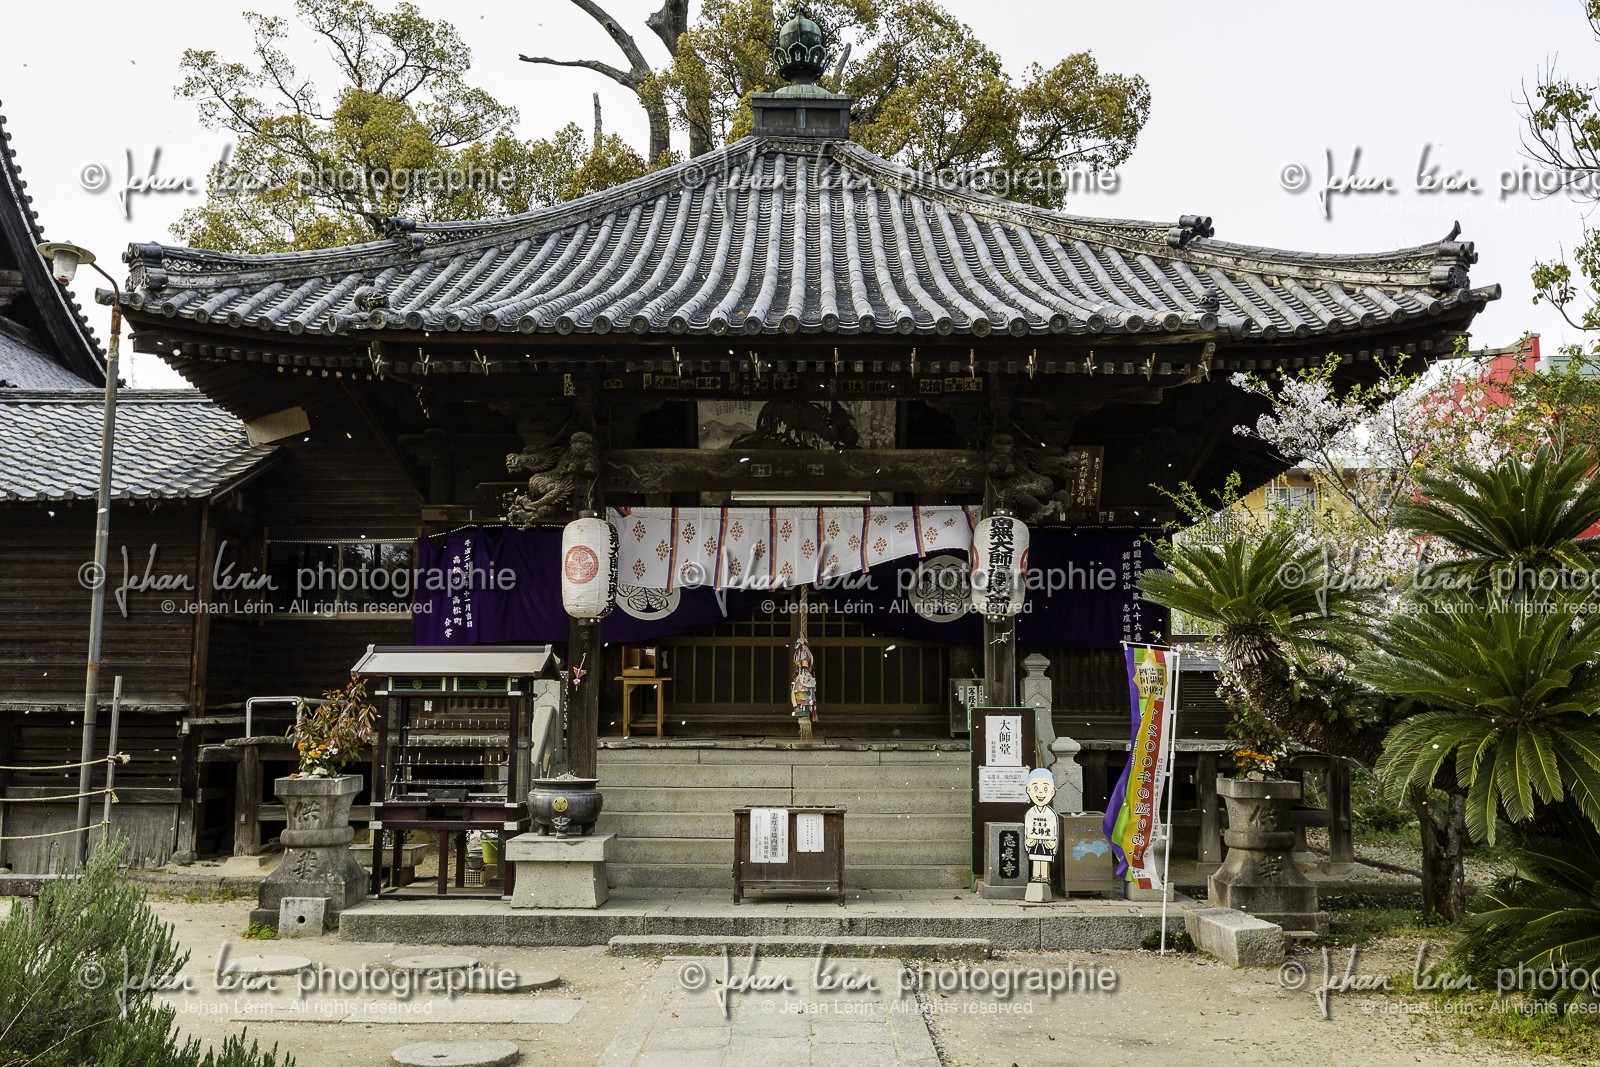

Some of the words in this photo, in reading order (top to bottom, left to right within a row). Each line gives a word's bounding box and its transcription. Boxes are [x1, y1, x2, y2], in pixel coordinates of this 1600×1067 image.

[999, 719, 1011, 755] 大師堂
[1030, 827, 1051, 836] 大師堂
[1002, 832, 1016, 877] 志度寺
